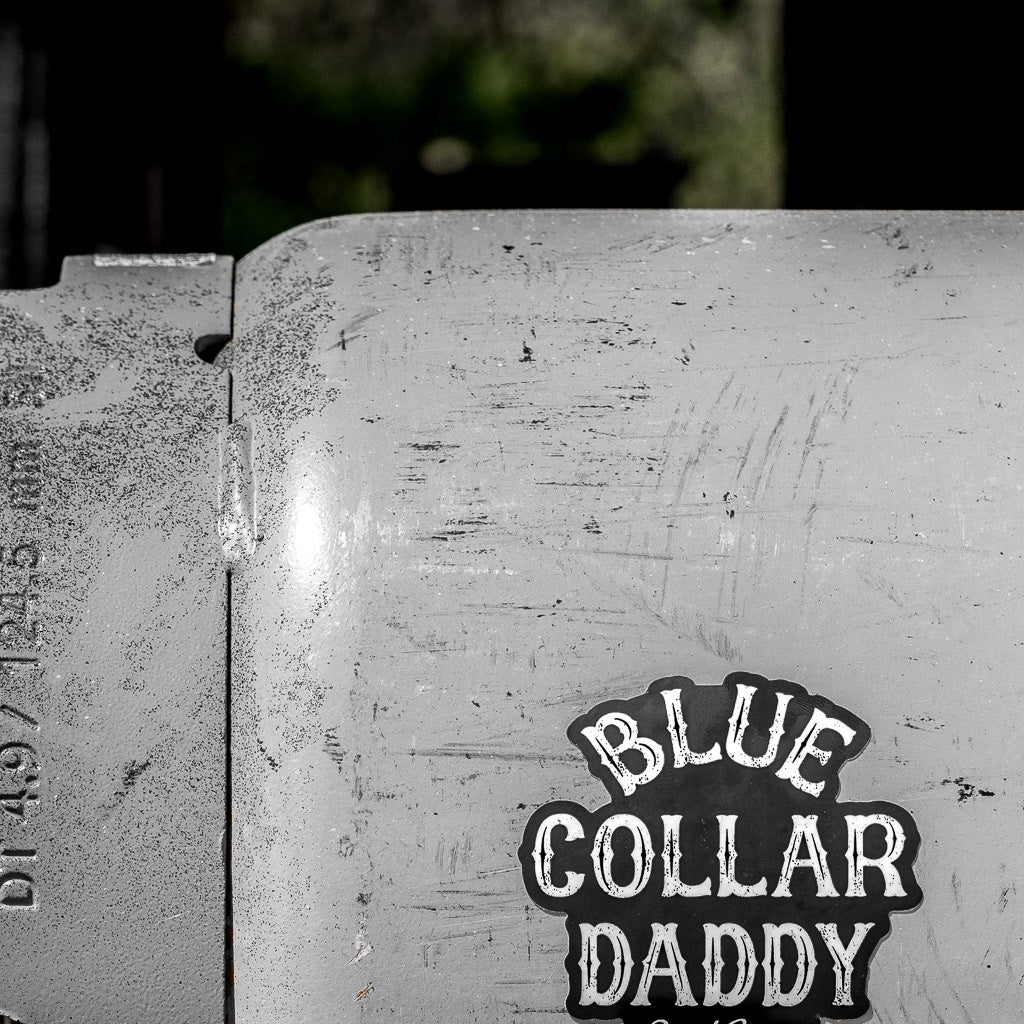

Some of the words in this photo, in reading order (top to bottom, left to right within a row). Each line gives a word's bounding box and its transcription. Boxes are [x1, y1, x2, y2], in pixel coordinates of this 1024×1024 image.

[581, 684, 857, 796] BLUE
[532, 814, 907, 898] COLLAR
[578, 922, 876, 1006] DADDY
